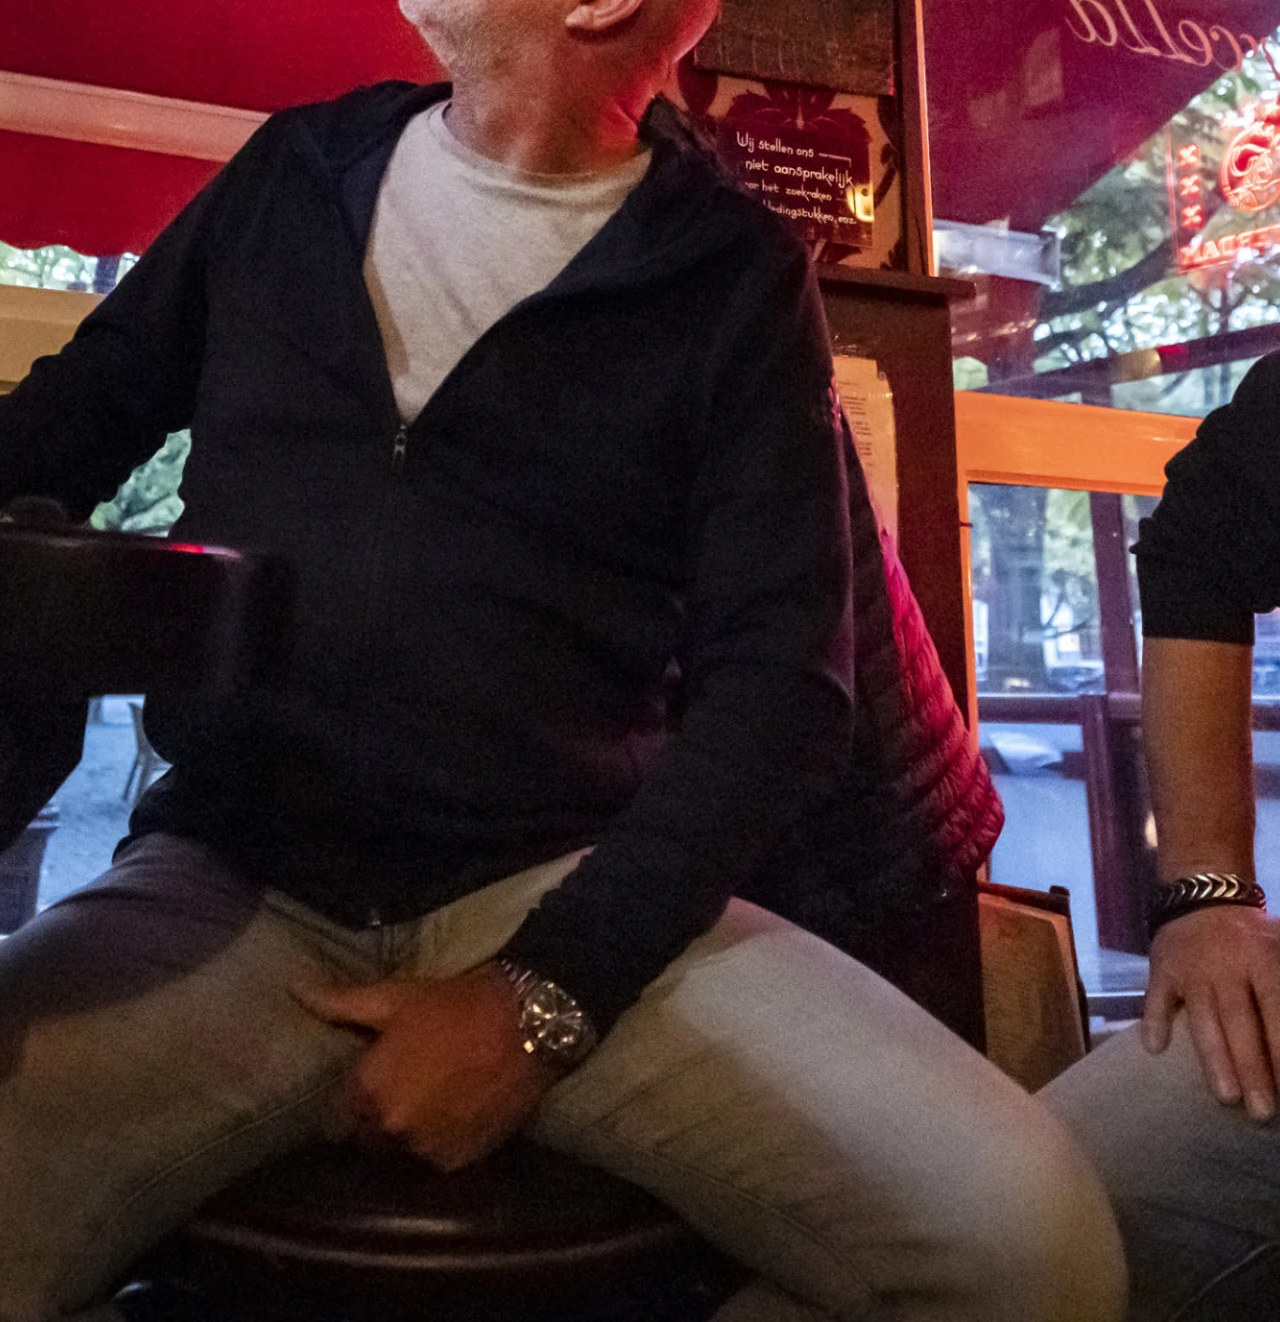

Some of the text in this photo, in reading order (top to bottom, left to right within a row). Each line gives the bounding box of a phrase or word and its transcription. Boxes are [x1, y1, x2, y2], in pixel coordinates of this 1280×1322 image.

[736, 130, 815, 159] Wij stellen ons
[745, 158, 855, 190] niet aansprakelijk
